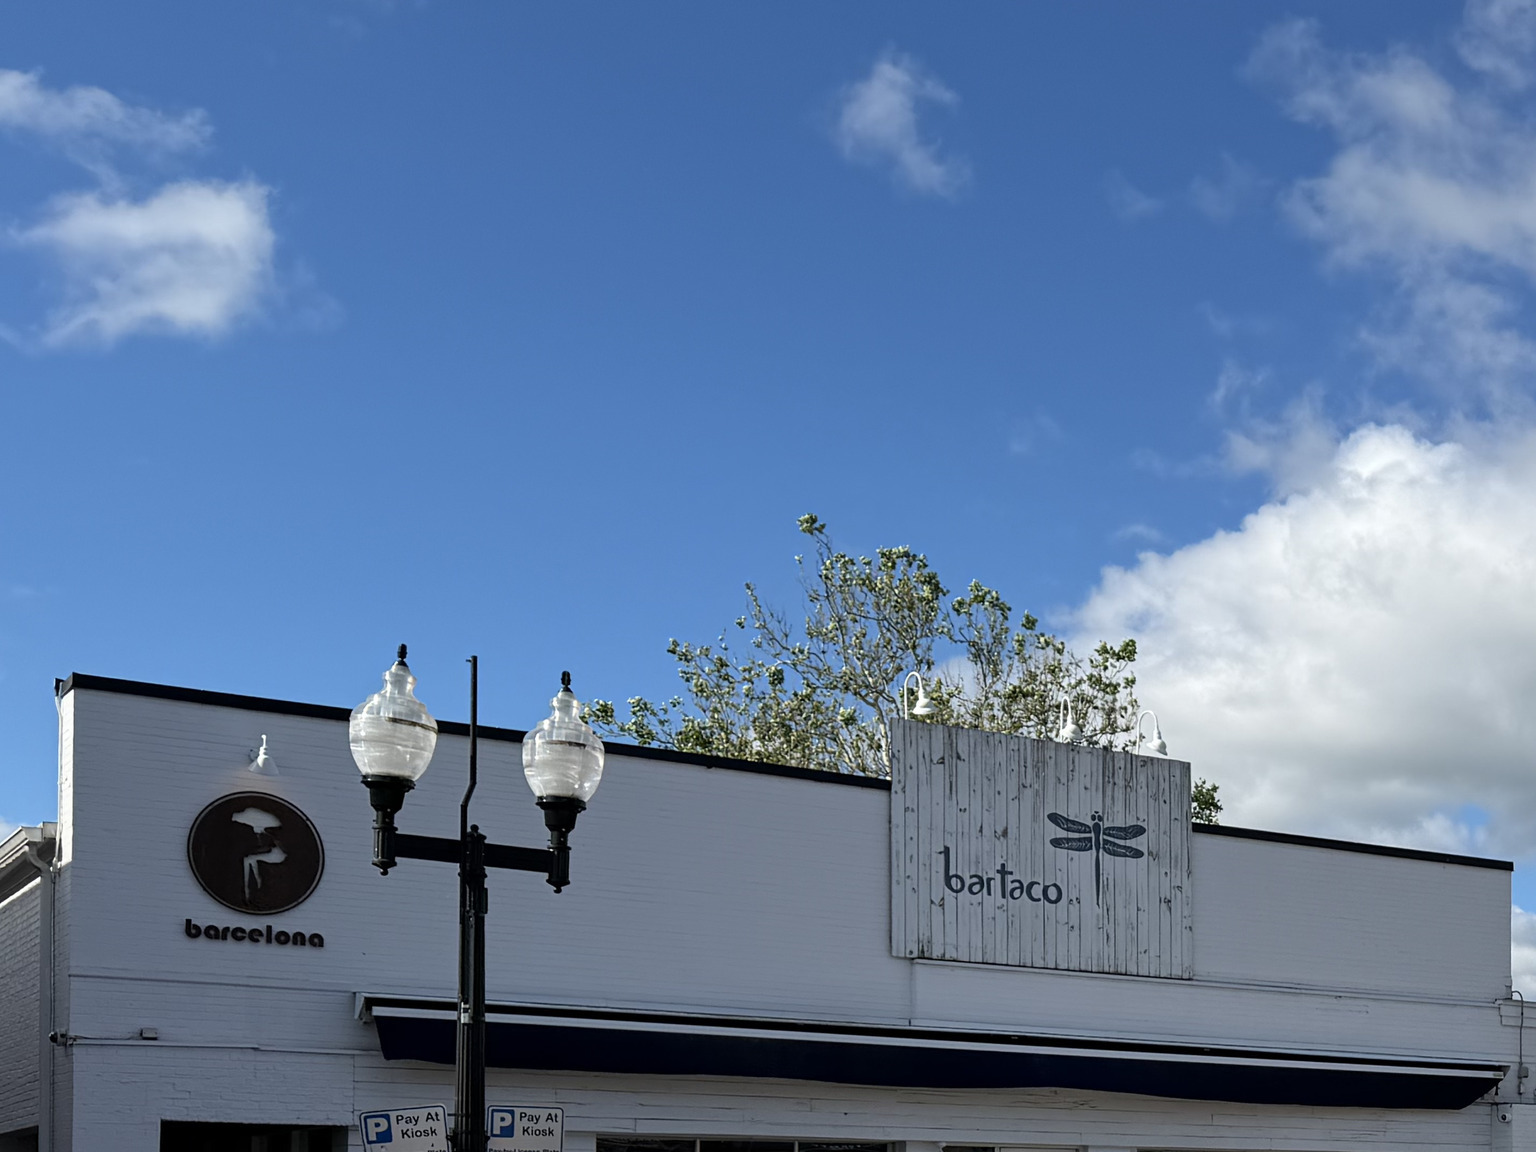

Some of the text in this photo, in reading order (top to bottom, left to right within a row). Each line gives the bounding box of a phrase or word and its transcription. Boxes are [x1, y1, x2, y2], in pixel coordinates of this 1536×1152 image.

[944, 845, 1063, 904] bartaco
[185, 918, 325, 948] barcelona
[396, 1111, 440, 1126] Pay At
[493, 1112, 512, 1135] P
[519, 1111, 559, 1125] Pay At
[367, 1117, 389, 1141] P
[401, 1127, 438, 1139] Kiosk
[522, 1126, 554, 1137] Kiosk
